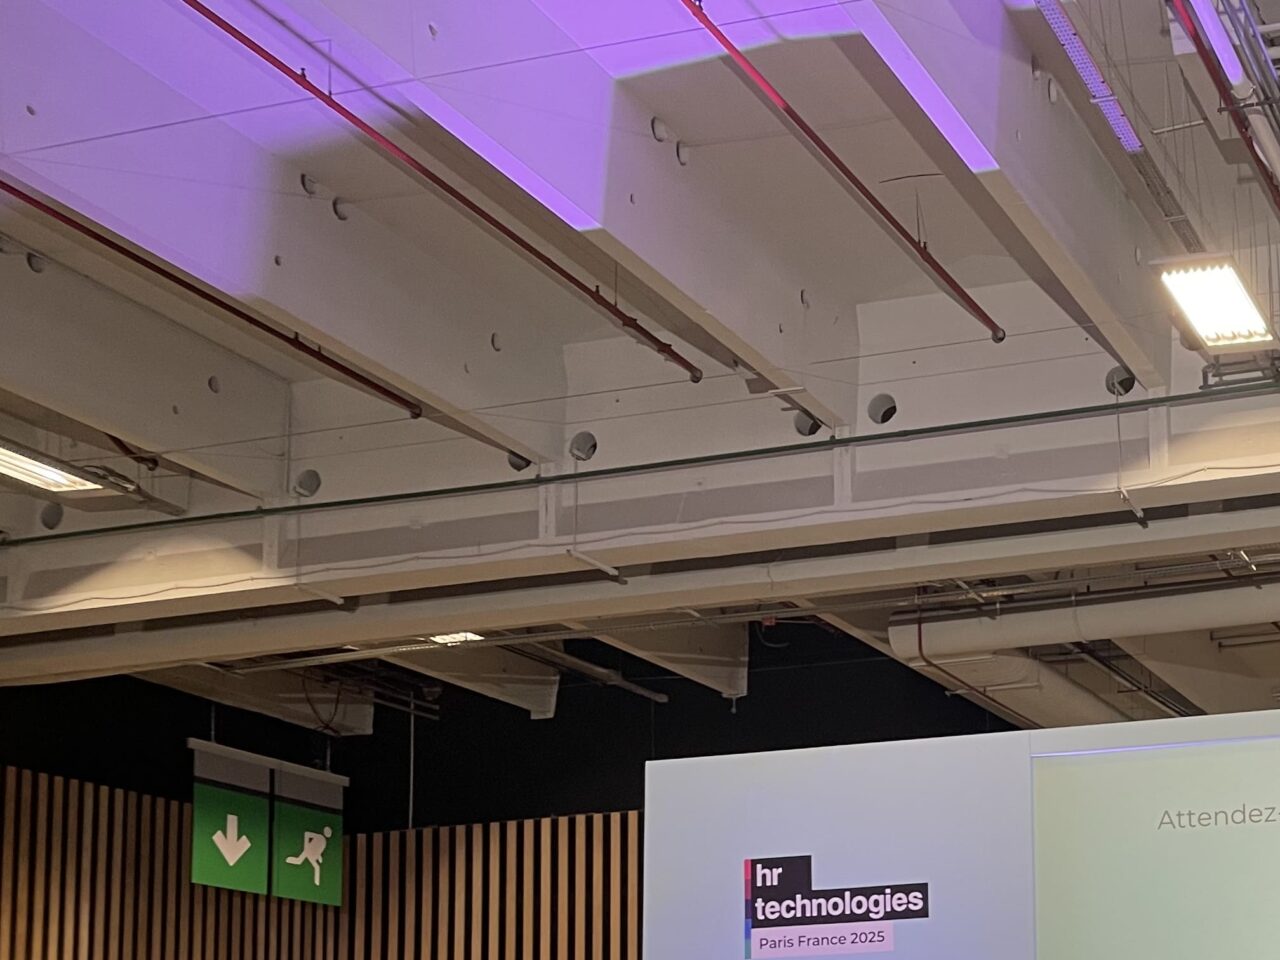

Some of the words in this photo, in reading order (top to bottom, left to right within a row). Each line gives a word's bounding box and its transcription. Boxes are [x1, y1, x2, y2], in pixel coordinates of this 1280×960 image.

[755, 863, 783, 887] hr
[755, 888, 924, 920] technologies
[759, 936, 794, 950] Paris
[798, 933, 847, 948] France
[850, 930, 885, 944] 2025
